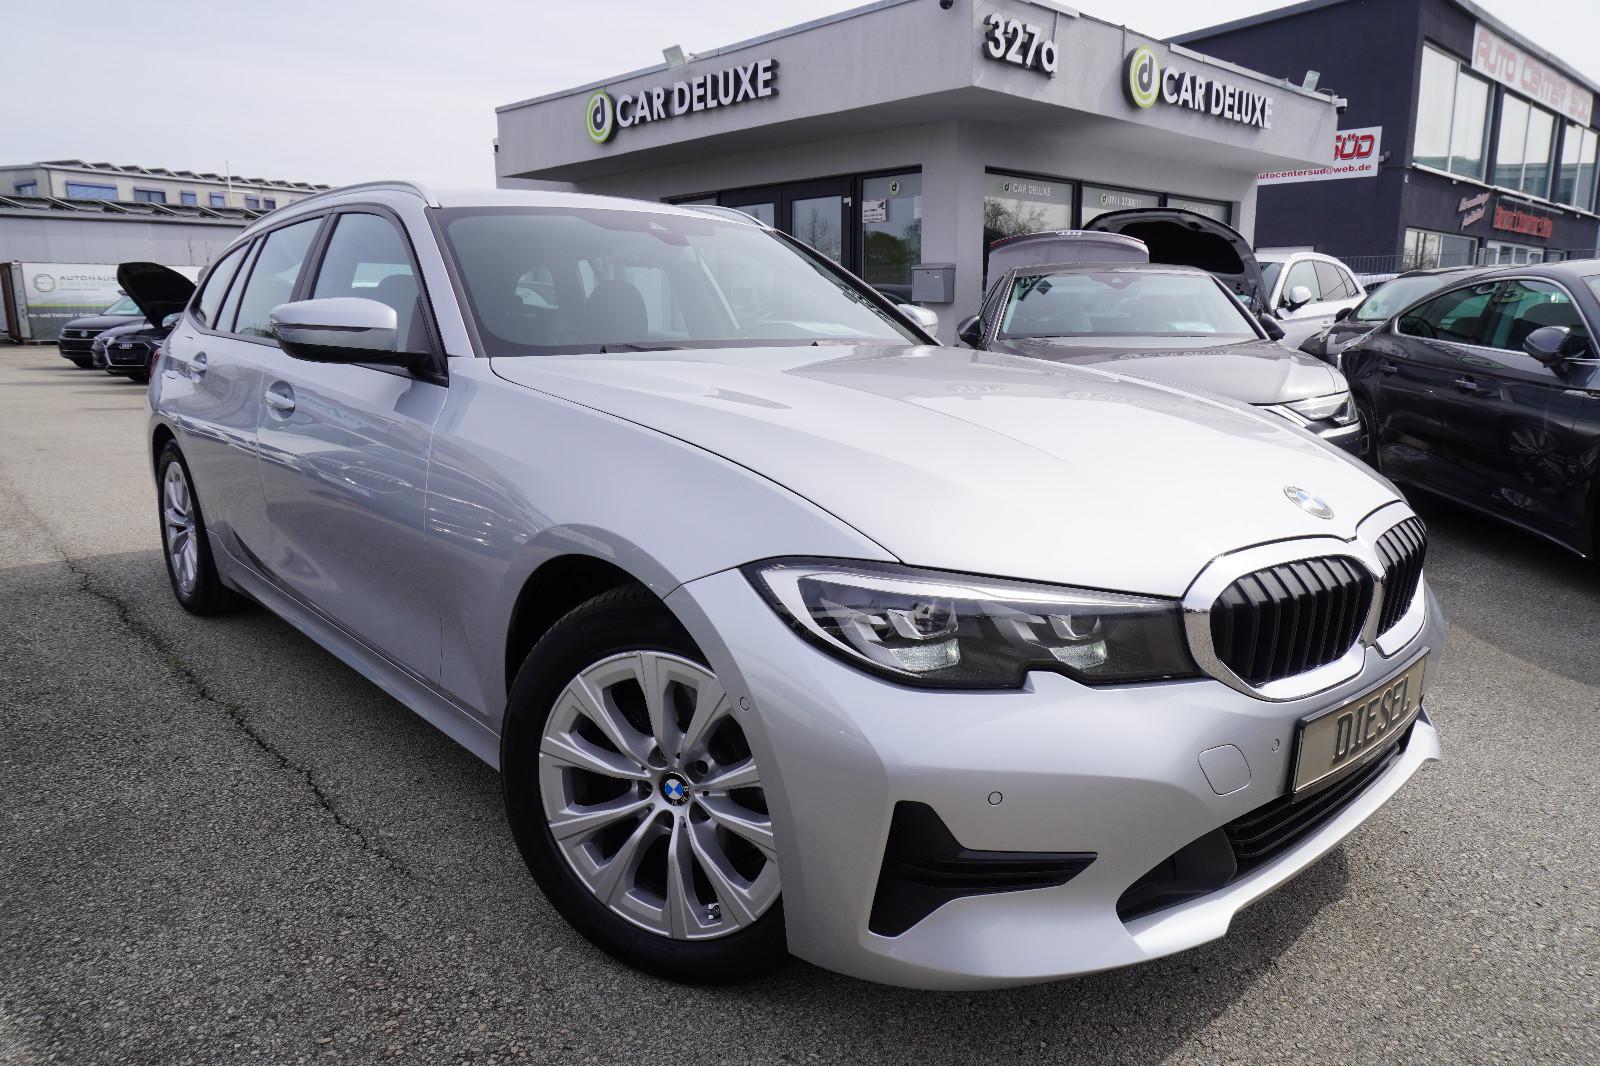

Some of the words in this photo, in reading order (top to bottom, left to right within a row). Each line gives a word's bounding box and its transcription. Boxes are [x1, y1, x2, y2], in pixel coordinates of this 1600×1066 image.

[986, 13, 1058, 73] 327a
[616, 87, 666, 128] CAR
[673, 58, 774, 116] DELUXE
[1162, 66, 1206, 112] CAR
[1210, 80, 1274, 129] DELUXE
[1012, 183, 1027, 194] CAR
[1028, 184, 1051, 197] DELUXE
[1332, 674, 1411, 765] DIESEL
